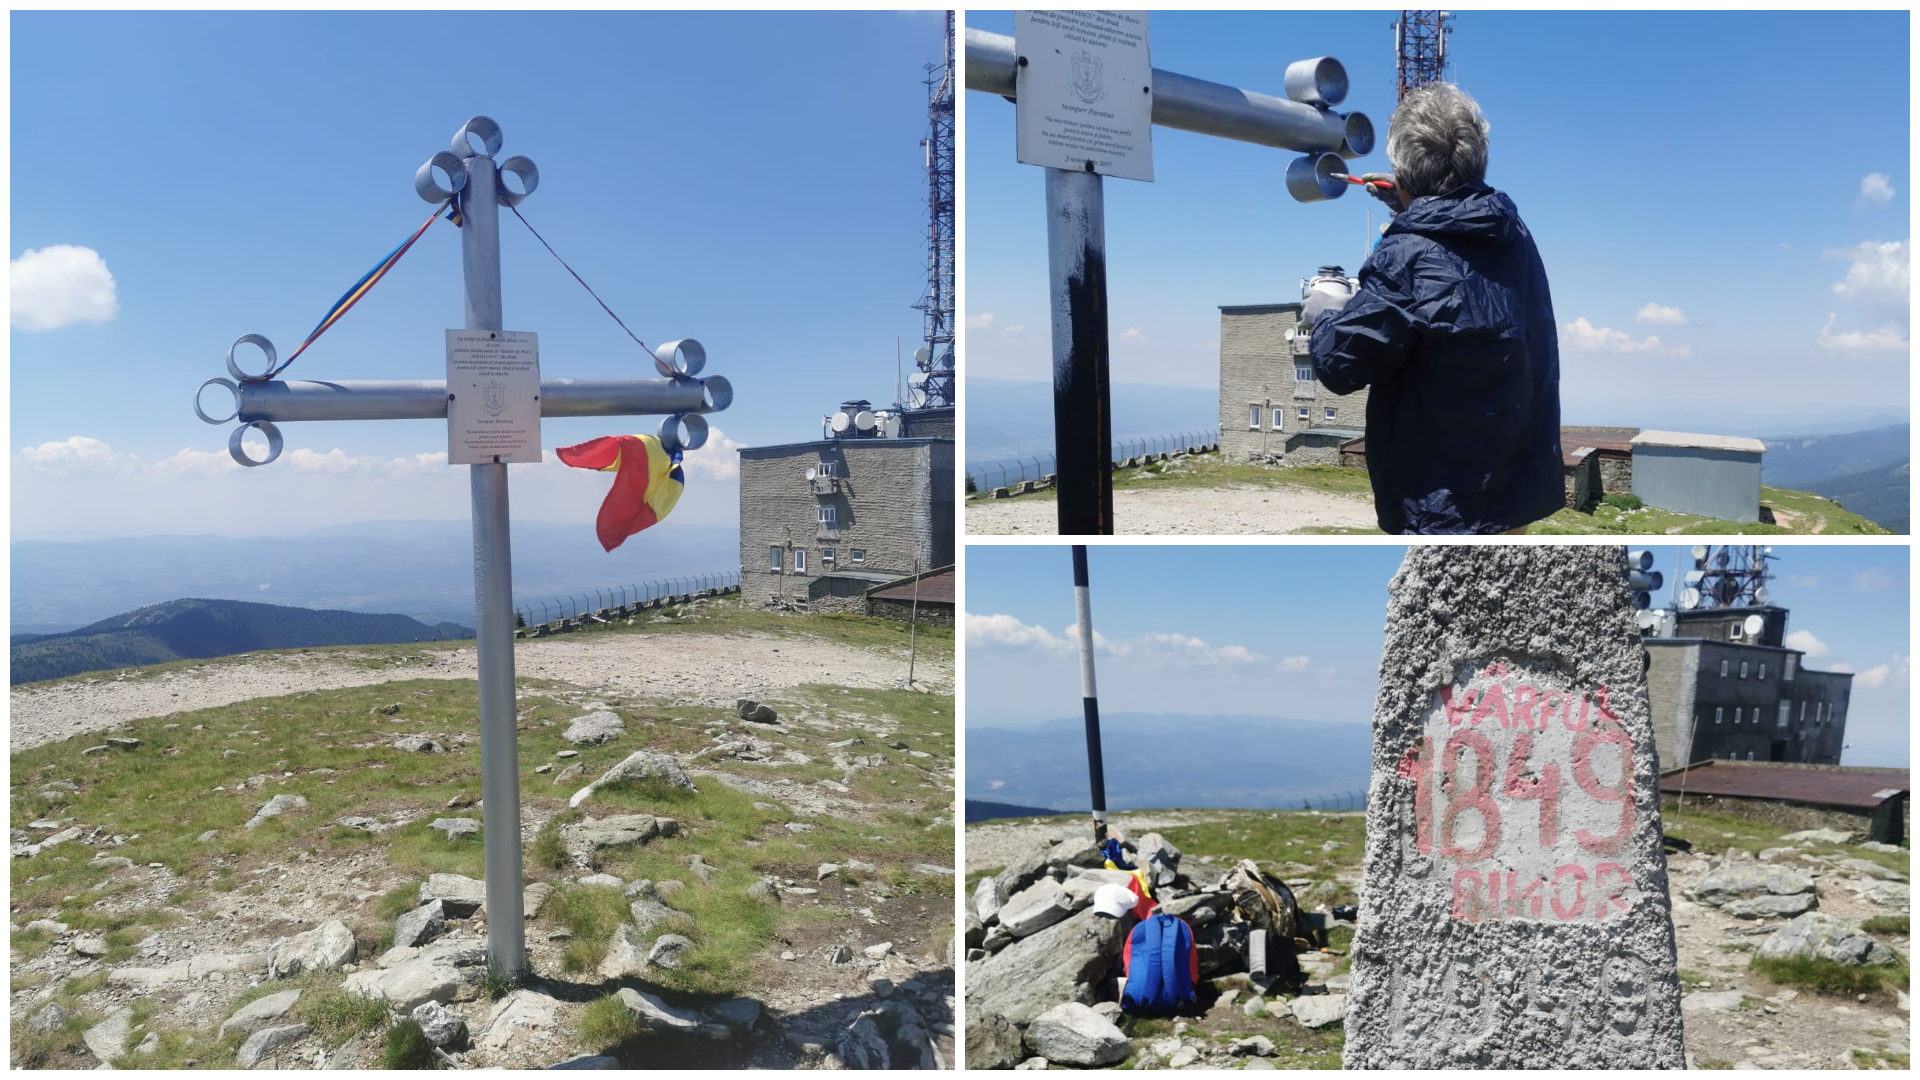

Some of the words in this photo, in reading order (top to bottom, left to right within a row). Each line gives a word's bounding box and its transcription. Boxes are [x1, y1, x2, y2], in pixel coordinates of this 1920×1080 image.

[1060, 103, 1088, 115] Semper
[1397, 728, 1637, 863] 1849
[1452, 862, 1634, 922] BIHOR
